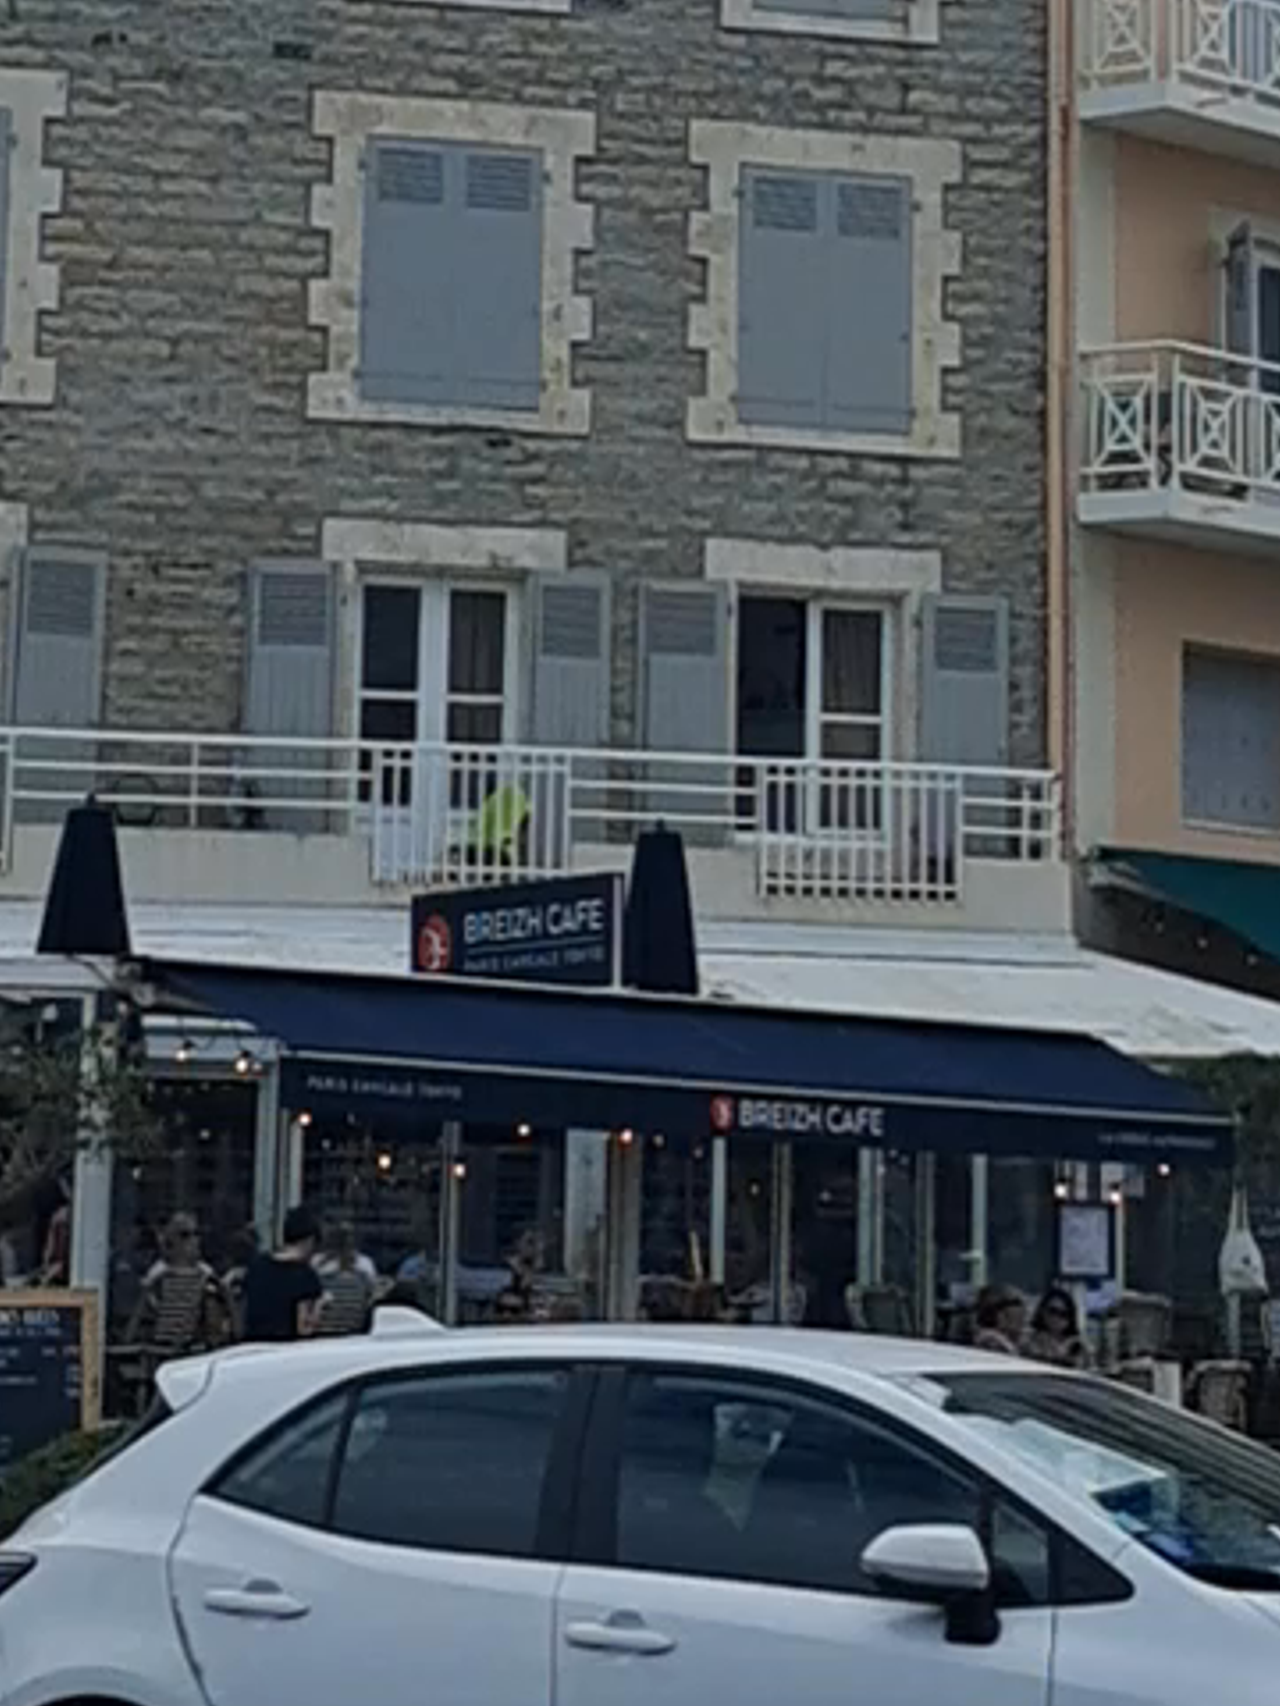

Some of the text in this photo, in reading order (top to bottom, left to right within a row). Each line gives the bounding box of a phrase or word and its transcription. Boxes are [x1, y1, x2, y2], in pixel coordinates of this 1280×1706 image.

[463, 898, 605, 944] BREIZH CAFE
[738, 1099, 885, 1136] BREIZH CAFE
